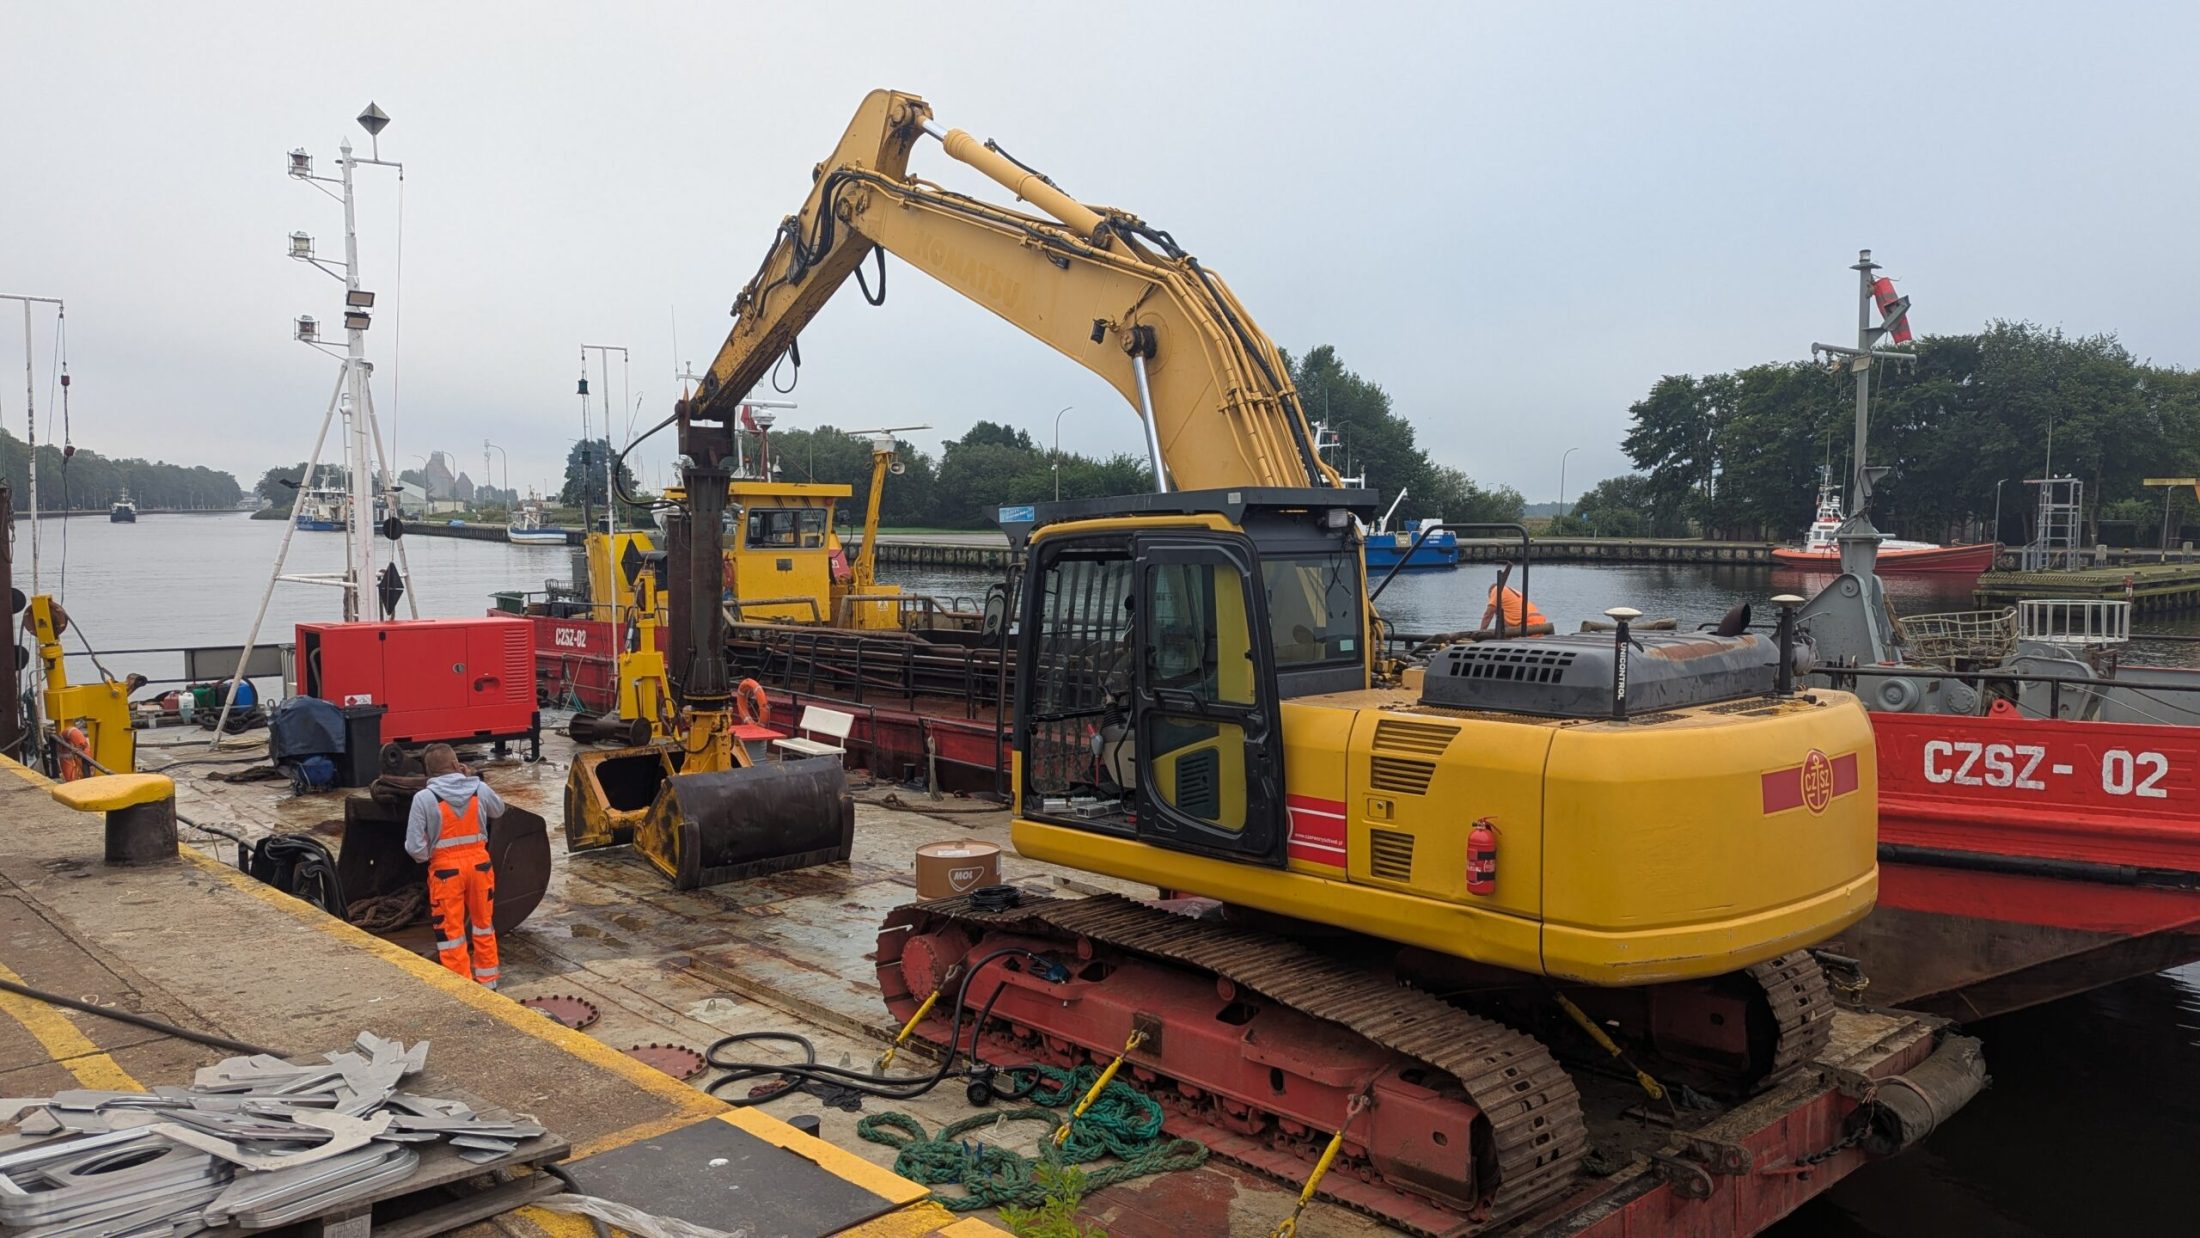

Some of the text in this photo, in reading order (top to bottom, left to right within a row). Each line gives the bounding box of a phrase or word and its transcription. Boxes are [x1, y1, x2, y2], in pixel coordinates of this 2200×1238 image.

[555, 627, 587, 648] CZSZ-02
[1617, 642, 1627, 701] UNICONTROL
[2102, 749, 2169, 798] 02
